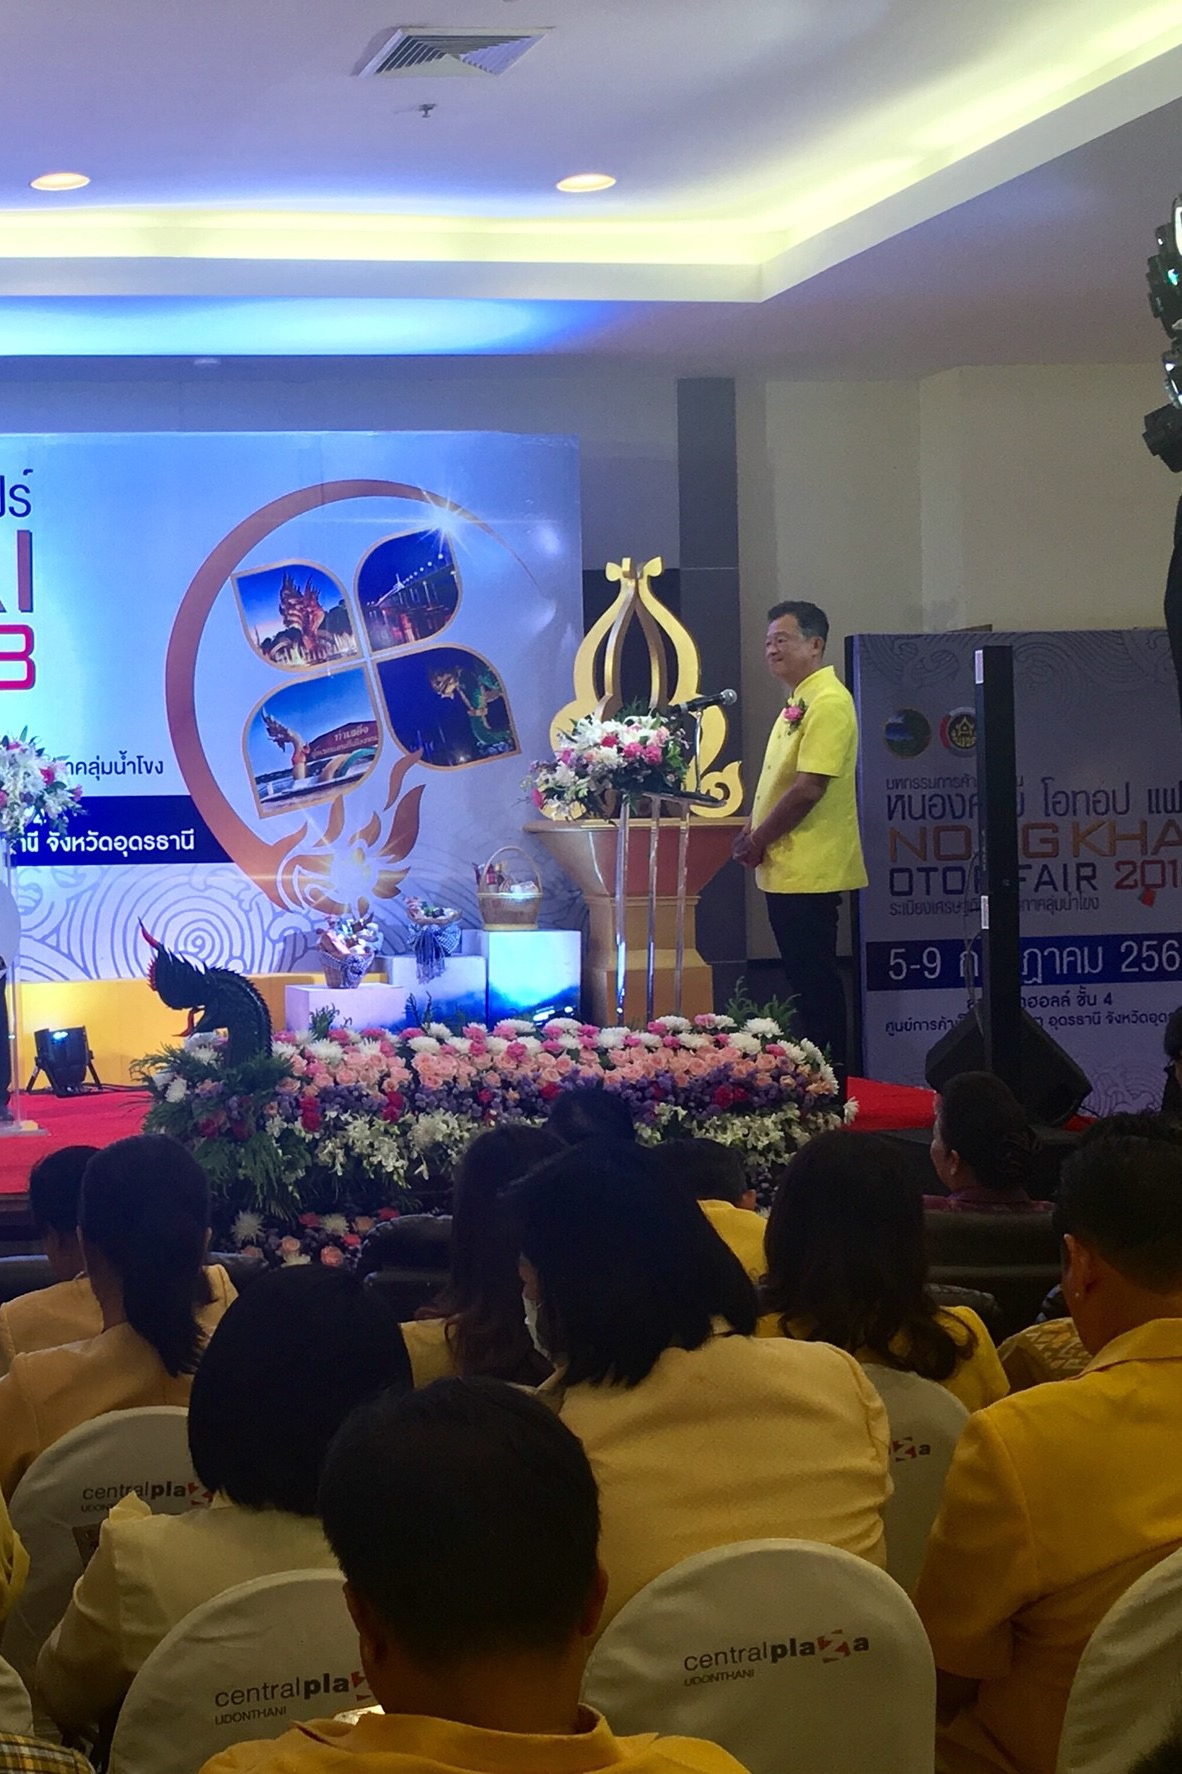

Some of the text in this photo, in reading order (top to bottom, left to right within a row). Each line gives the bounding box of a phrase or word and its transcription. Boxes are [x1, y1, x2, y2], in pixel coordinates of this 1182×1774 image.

[1041, 776, 1130, 817] โอทอป
[1147, 781, 1182, 814] แฟ
[46, 829, 195, 858] จังหวัดอุดรธานี
[889, 821, 1060, 863] NOG
[1071, 818, 1182, 859] KHA
[1114, 859, 1182, 890] 201
[888, 939, 1182, 984] 5-9 กฎาคม 256
[1102, 992, 1113, 1006] 4
[1105, 1009, 1171, 1028] จังหวัดอุด
[683, 1628, 871, 1672] centralplaza
[683, 1668, 756, 1687] UDONTHANI
[214, 1706, 288, 1726] UDONTHANI
